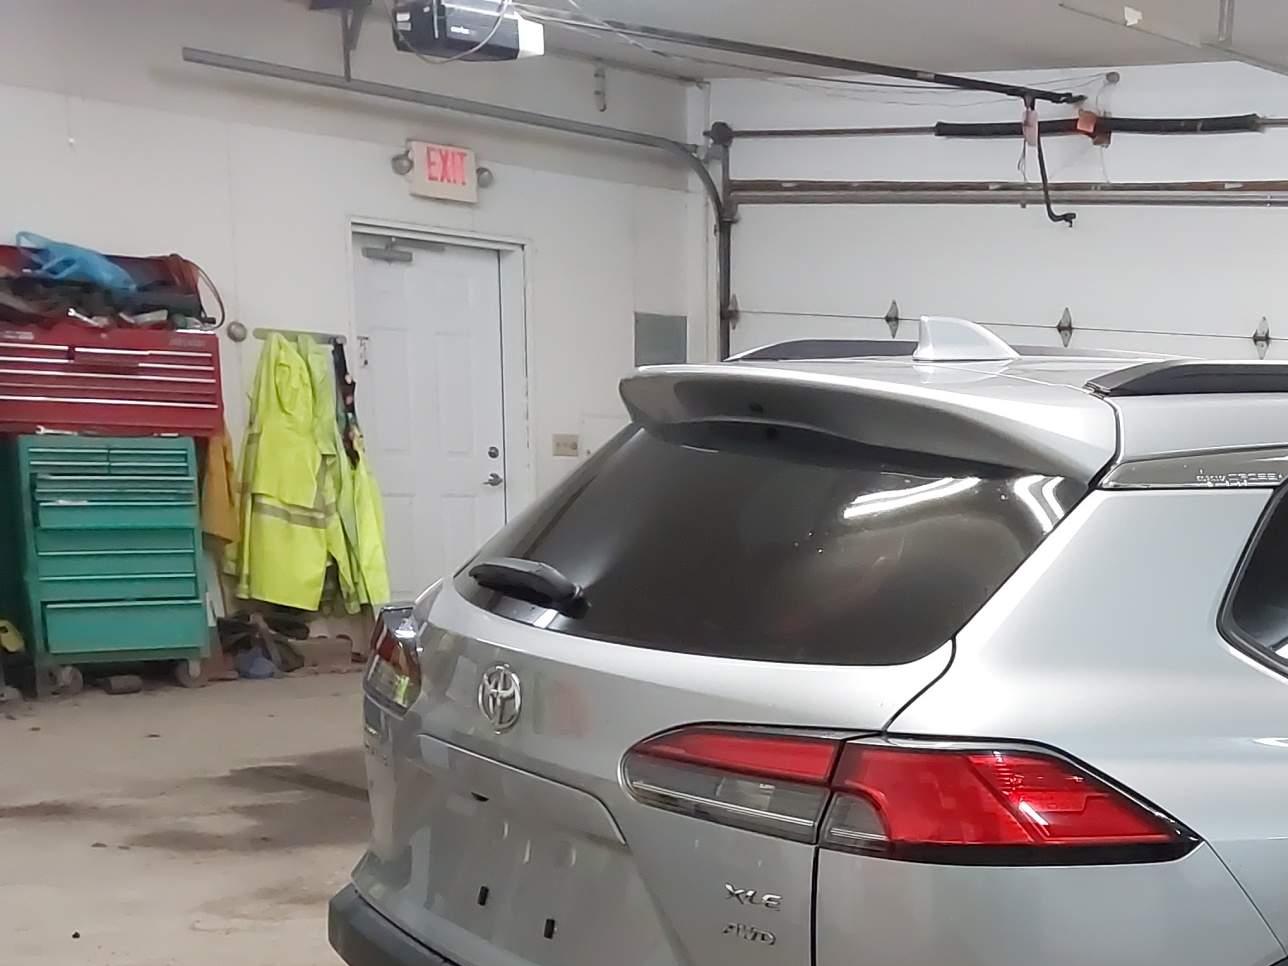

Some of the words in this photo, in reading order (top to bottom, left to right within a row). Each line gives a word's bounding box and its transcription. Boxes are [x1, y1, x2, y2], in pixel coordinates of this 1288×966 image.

[427, 146, 467, 185] EXIT
[725, 882, 783, 911] XLE
[723, 921, 776, 945] AWD
